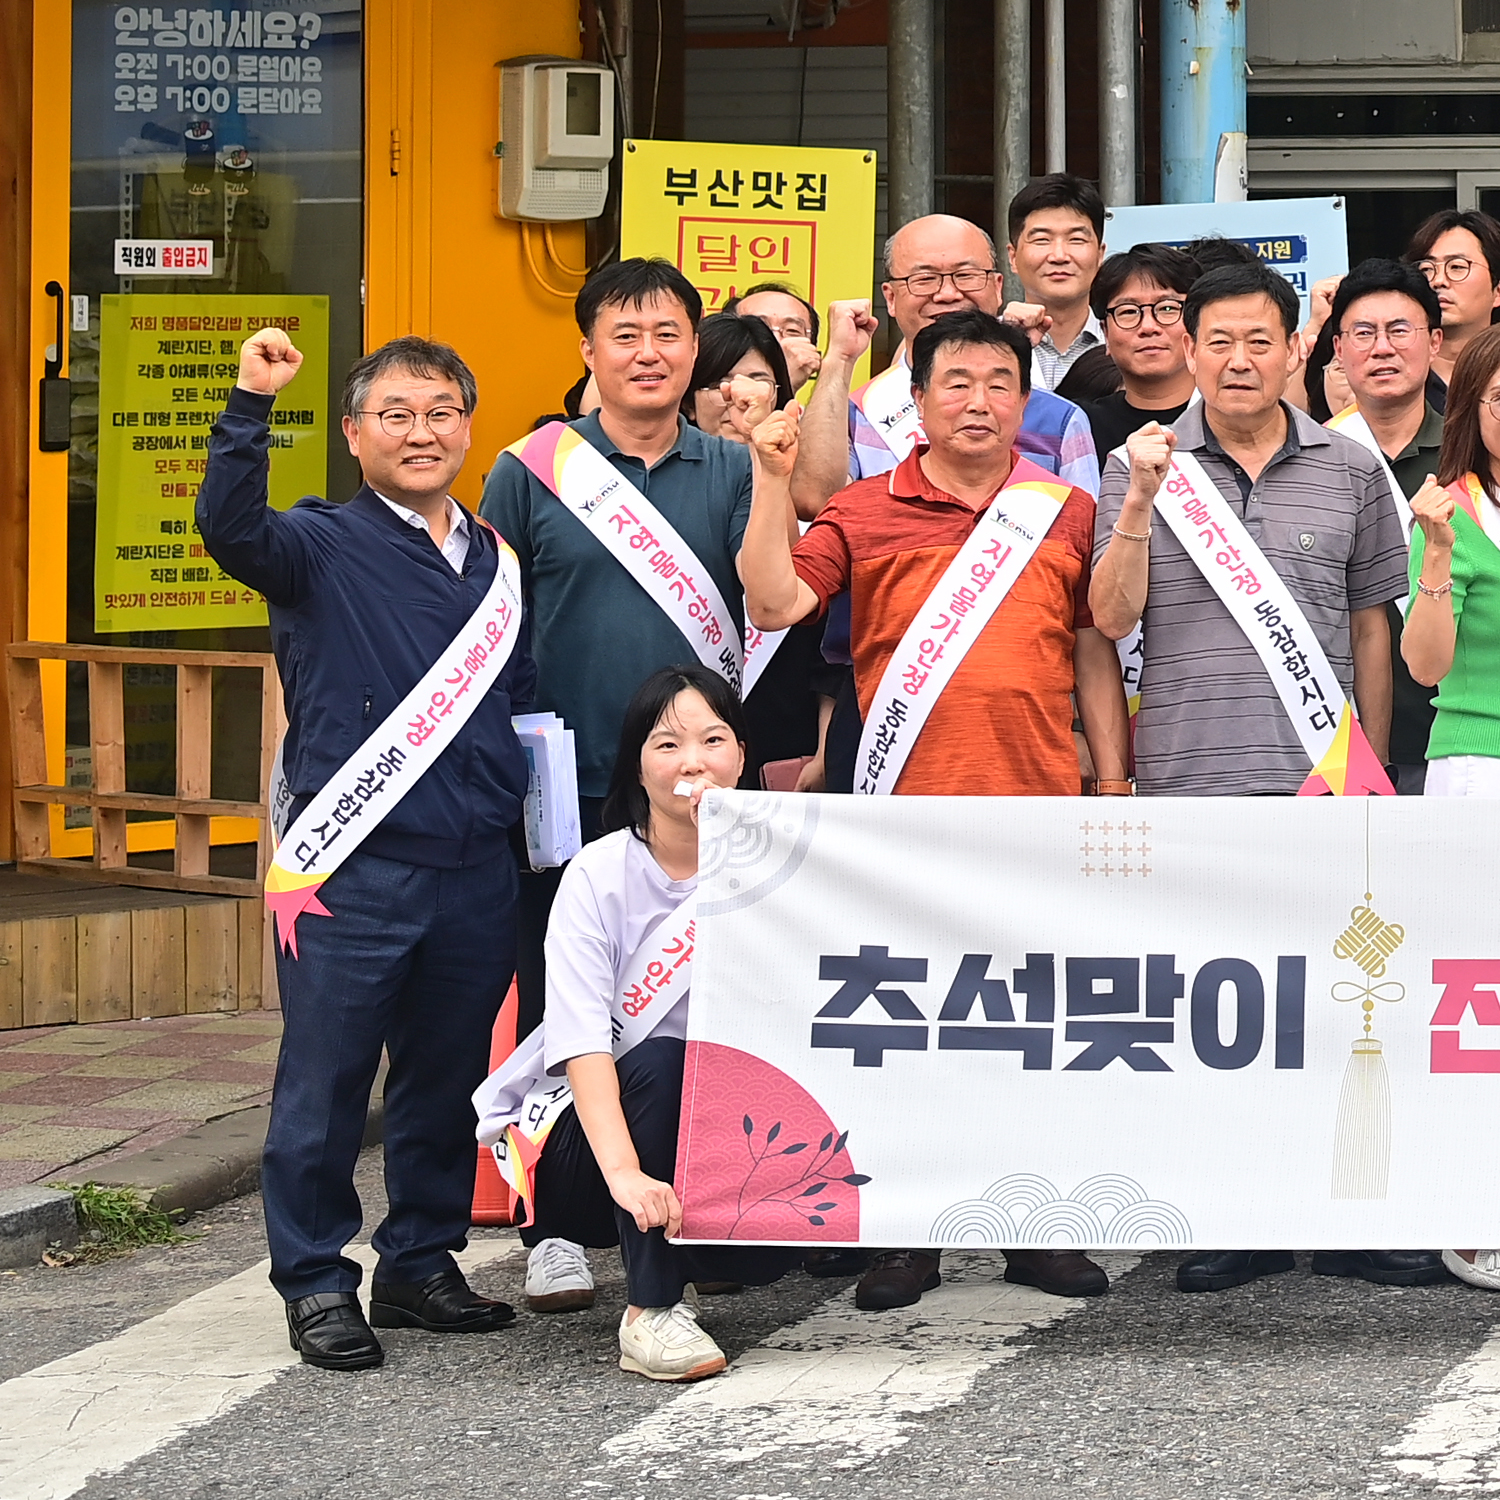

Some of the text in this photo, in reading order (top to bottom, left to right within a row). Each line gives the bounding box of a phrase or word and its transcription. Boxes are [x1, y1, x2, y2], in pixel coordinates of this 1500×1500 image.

[114, 6, 322, 50] 안녕하세요?
[114, 52, 322, 83] 오전 7:00 문열어요
[114, 83, 322, 115] 오후 7:00 문닫아요
[664, 167, 828, 212] 부산맛집
[120, 246, 208, 268] 직원외 출입금지
[697, 234, 791, 275] 달인
[1255, 240, 1292, 261] 지원
[130, 316, 157, 331] 저희
[161, 316, 243, 332] 명품달인김밥
[156, 339, 216, 356] 계란지단,
[138, 363, 165, 380] 각종
[171, 387, 200, 403] 모든
[112, 411, 139, 428] 다른
[143, 410, 171, 427] 대형
[131, 435, 187, 452] 공장에서
[154, 459, 182, 474] 모두
[159, 520, 188, 535] 특히
[114, 544, 185, 561] 계란지단은
[149, 568, 178, 583] 직접
[608, 503, 724, 647] 지역물가안정
[104, 589, 255, 610] 맛있게 안전하게 드실 수
[901, 538, 1014, 696] 지역물가안정
[1253, 598, 1338, 734] 동참합시다
[293, 597, 514, 874] 지역물가안정 동참합시다
[810, 944, 1307, 1073] 추석맞이
